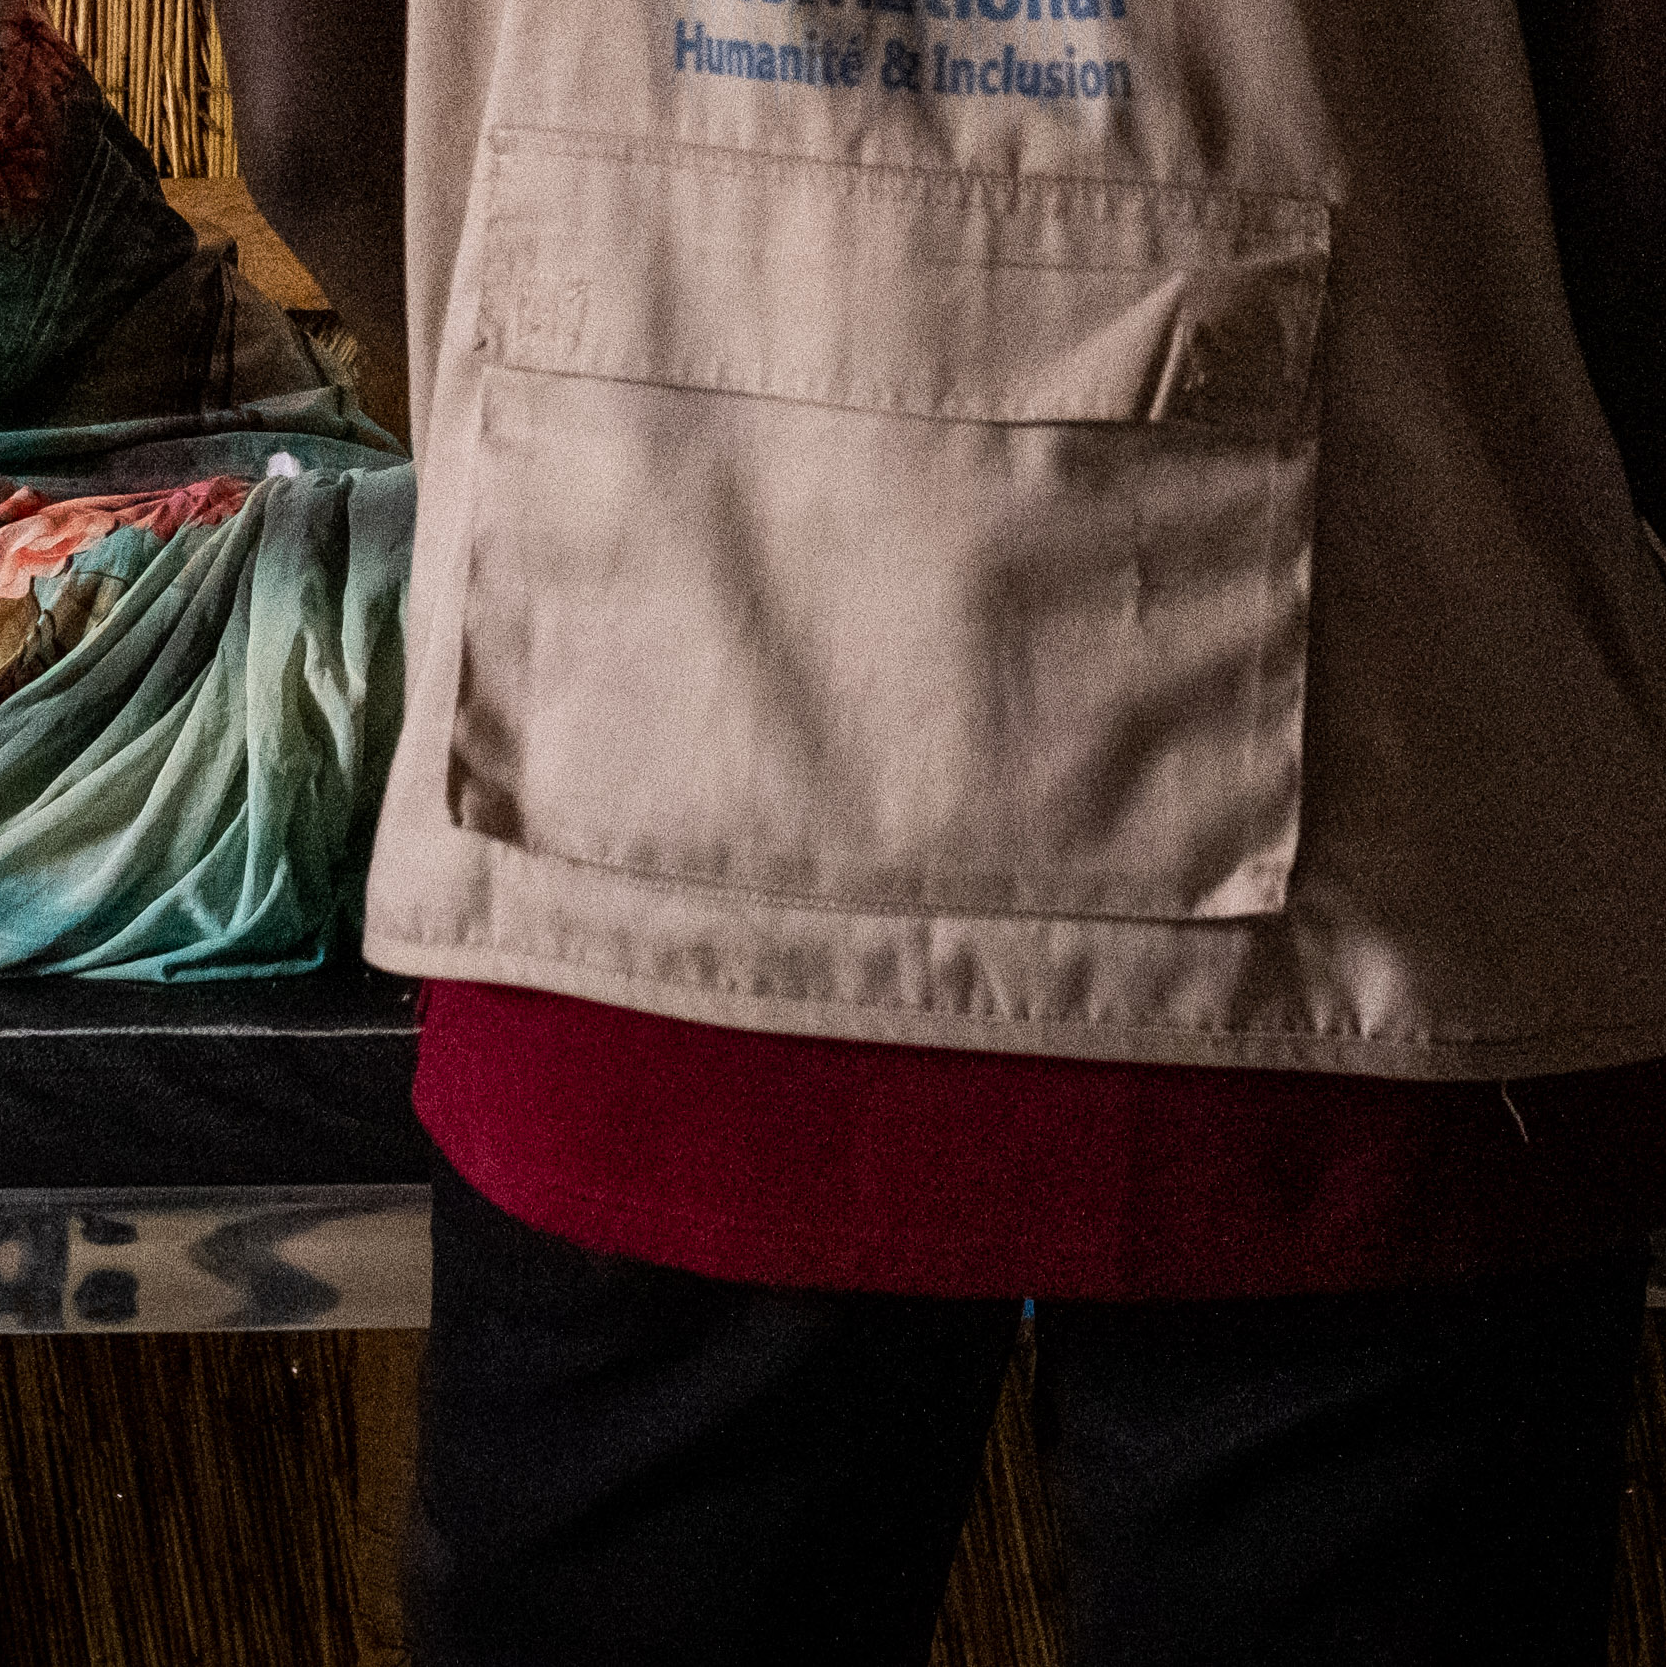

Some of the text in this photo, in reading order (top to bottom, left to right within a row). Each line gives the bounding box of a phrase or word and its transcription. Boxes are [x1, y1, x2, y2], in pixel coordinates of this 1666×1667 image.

[674, 18, 1131, 100] Humanité & Inclusion
